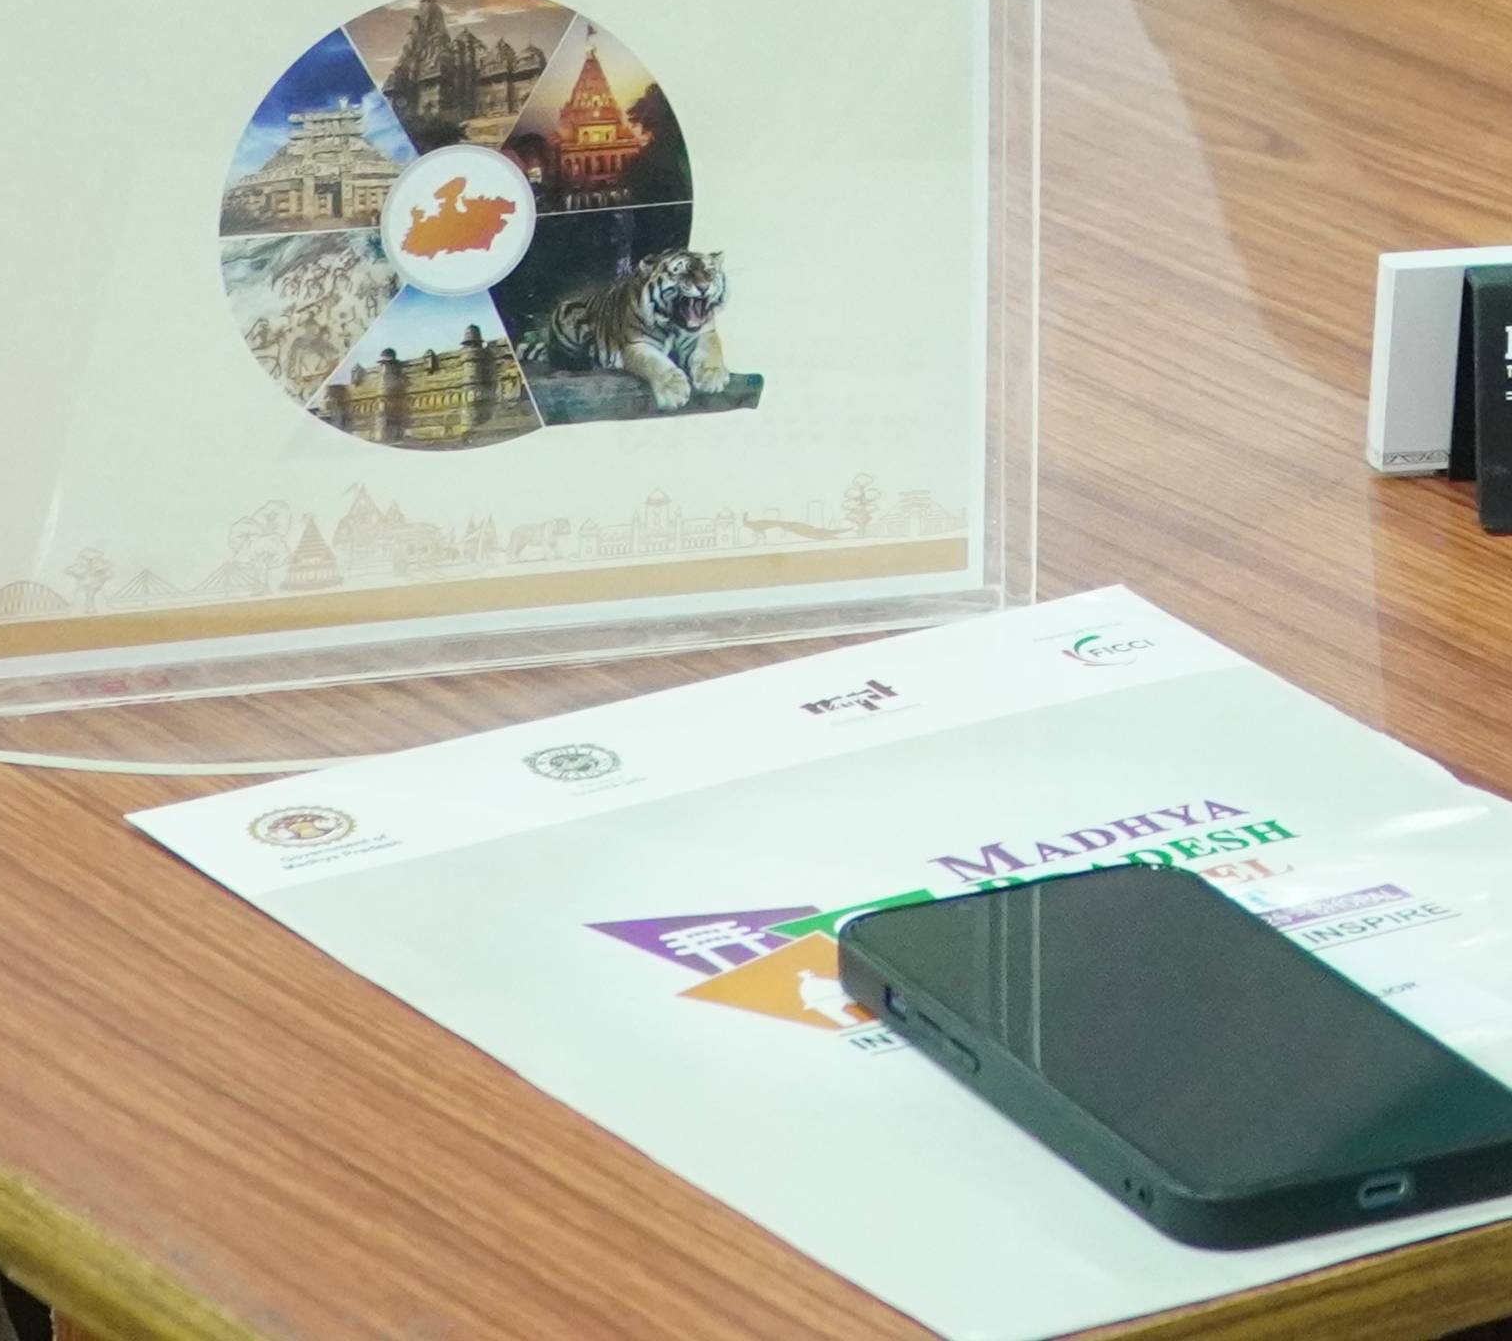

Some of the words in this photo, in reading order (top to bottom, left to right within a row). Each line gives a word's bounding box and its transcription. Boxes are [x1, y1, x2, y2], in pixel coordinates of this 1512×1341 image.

[1088, 637, 1157, 659] FICCI
[927, 799, 1250, 884] MADHYA
[965, 818, 1301, 892] DESH
[1301, 901, 1454, 945] INSPIRE
